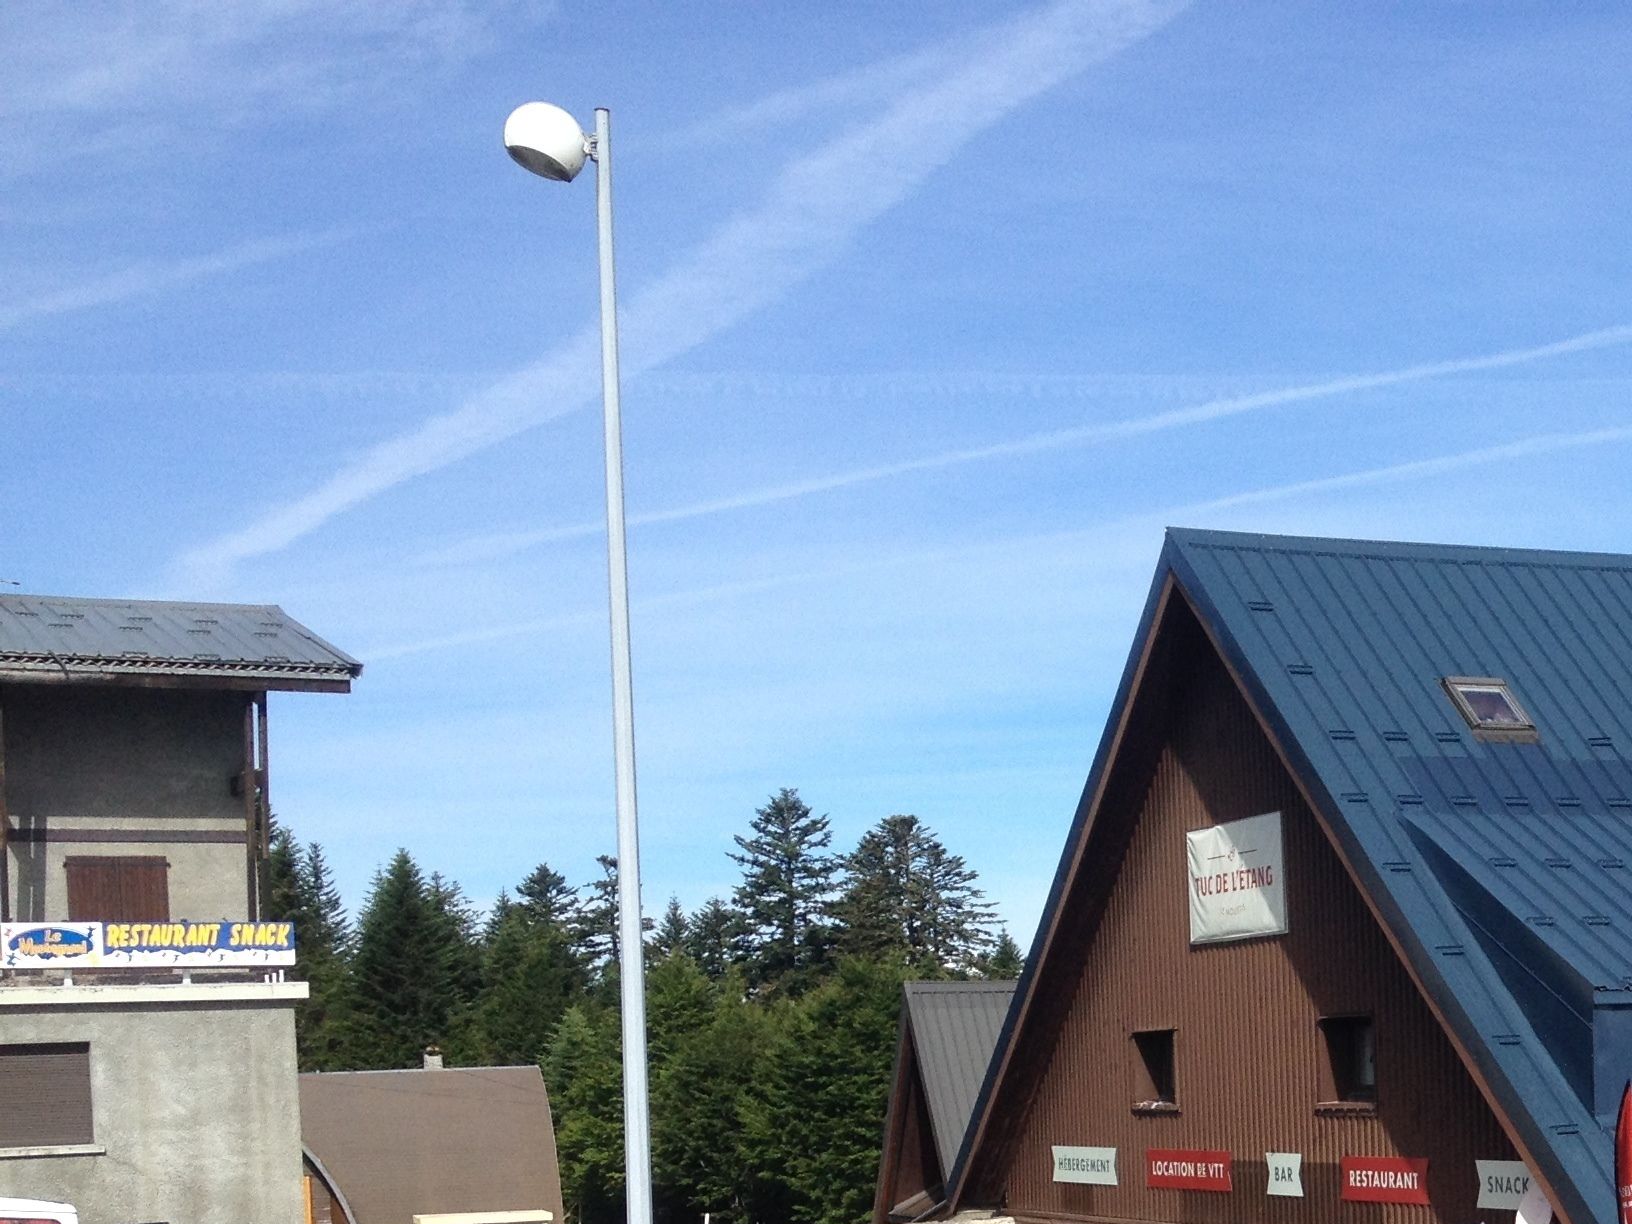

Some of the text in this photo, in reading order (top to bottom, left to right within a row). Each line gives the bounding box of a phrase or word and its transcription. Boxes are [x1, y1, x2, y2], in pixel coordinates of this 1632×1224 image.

[1195, 874, 1213, 897] TUC
[1216, 872, 1229, 894] DE
[107, 923, 290, 948] RESTAURANT SNACK
[1152, 1161, 1195, 1176] LOCATION
[1208, 1163, 1224, 1179] VTT
[1274, 1166, 1293, 1182] BAR
[1349, 1170, 1419, 1190] RESTAURANT
[1487, 1175, 1529, 1194] SNACK
